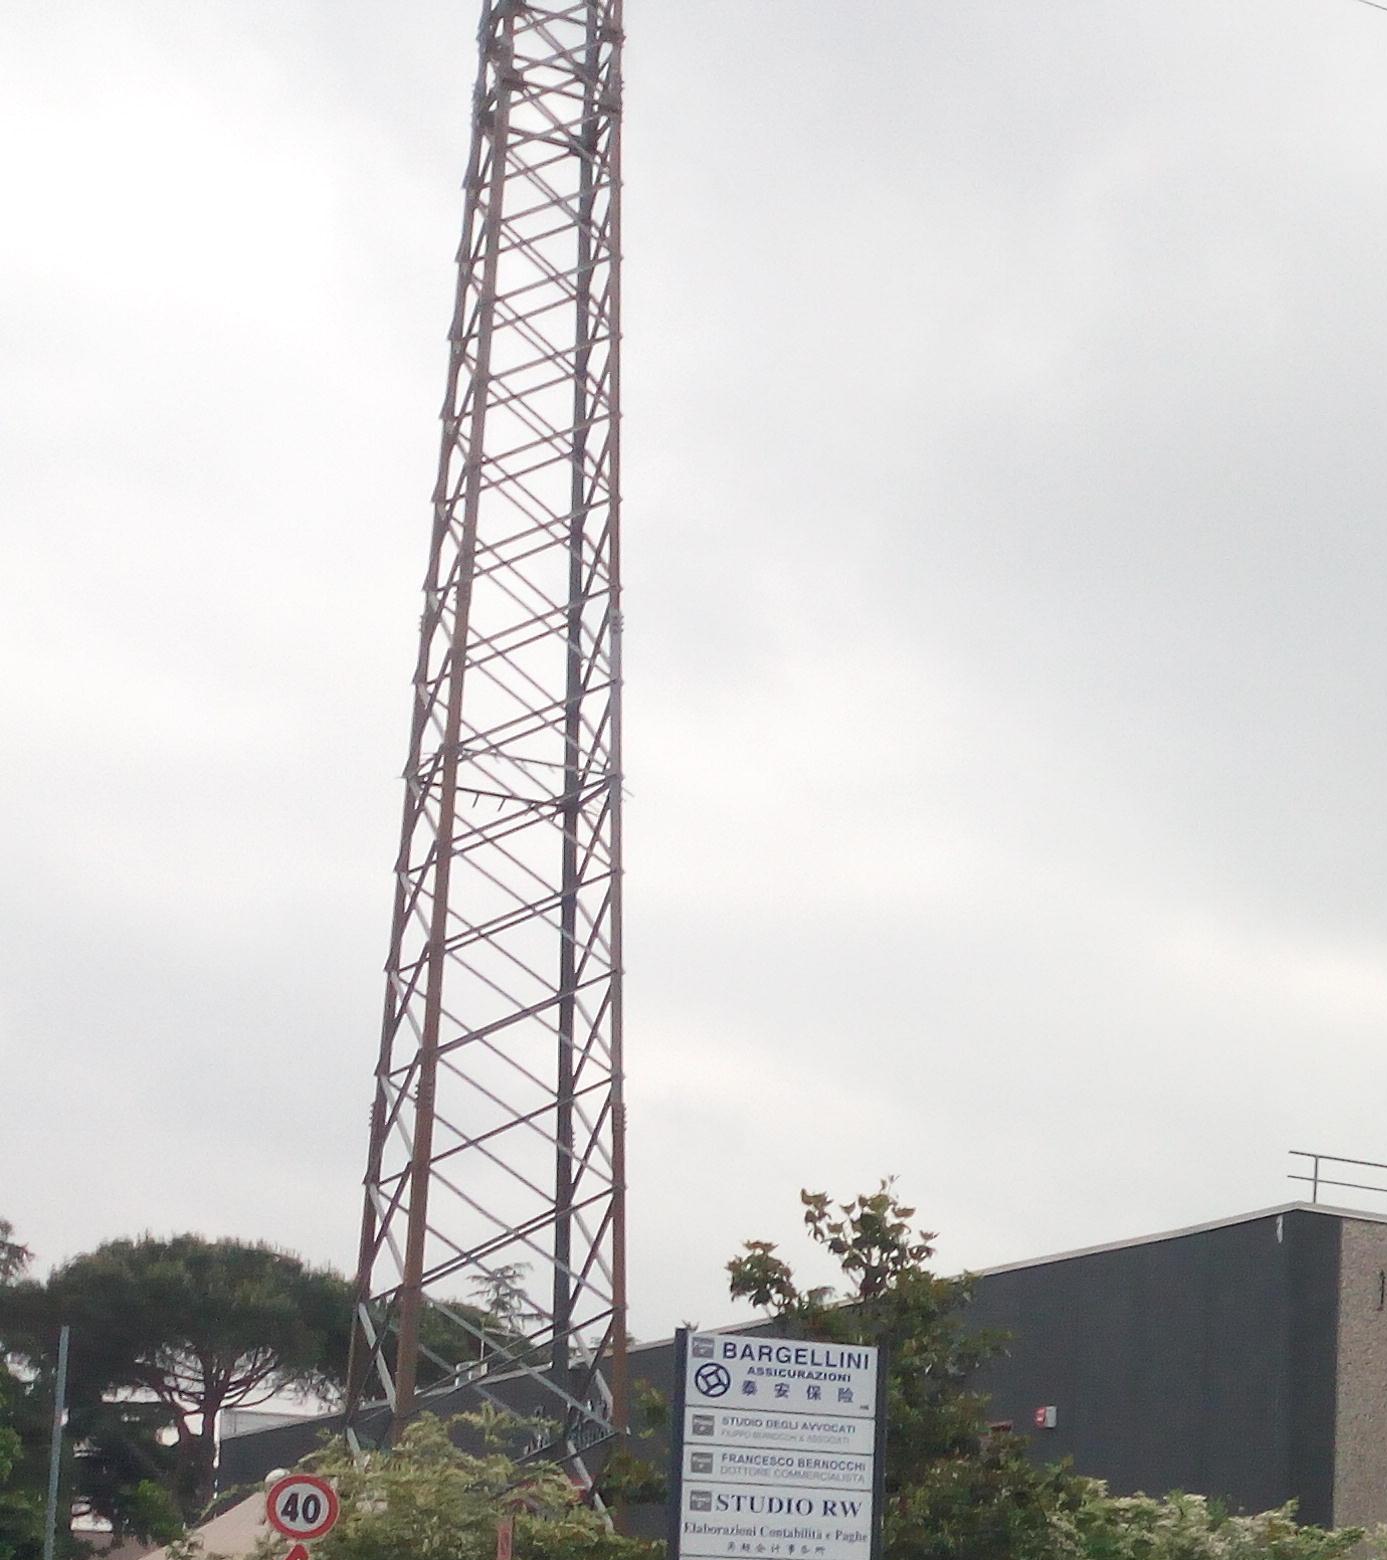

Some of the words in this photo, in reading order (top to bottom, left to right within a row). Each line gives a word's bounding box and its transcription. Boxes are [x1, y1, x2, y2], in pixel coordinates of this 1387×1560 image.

[723, 1342, 869, 1371] BARGELLINI
[747, 1366, 851, 1384] ASSICURAZIONI
[721, 1416, 763, 1428] STUDIO
[765, 1418, 799, 1431] DEGLI
[801, 1421, 857, 1434] AVVOCATI
[721, 1452, 794, 1468] FRANCESCO
[797, 1457, 866, 1471] BERNOCCHI
[281, 1492, 321, 1524] 40
[715, 1493, 813, 1516] STUDIO
[822, 1499, 863, 1518] RW
[684, 1521, 756, 1537] Elaborazioni
